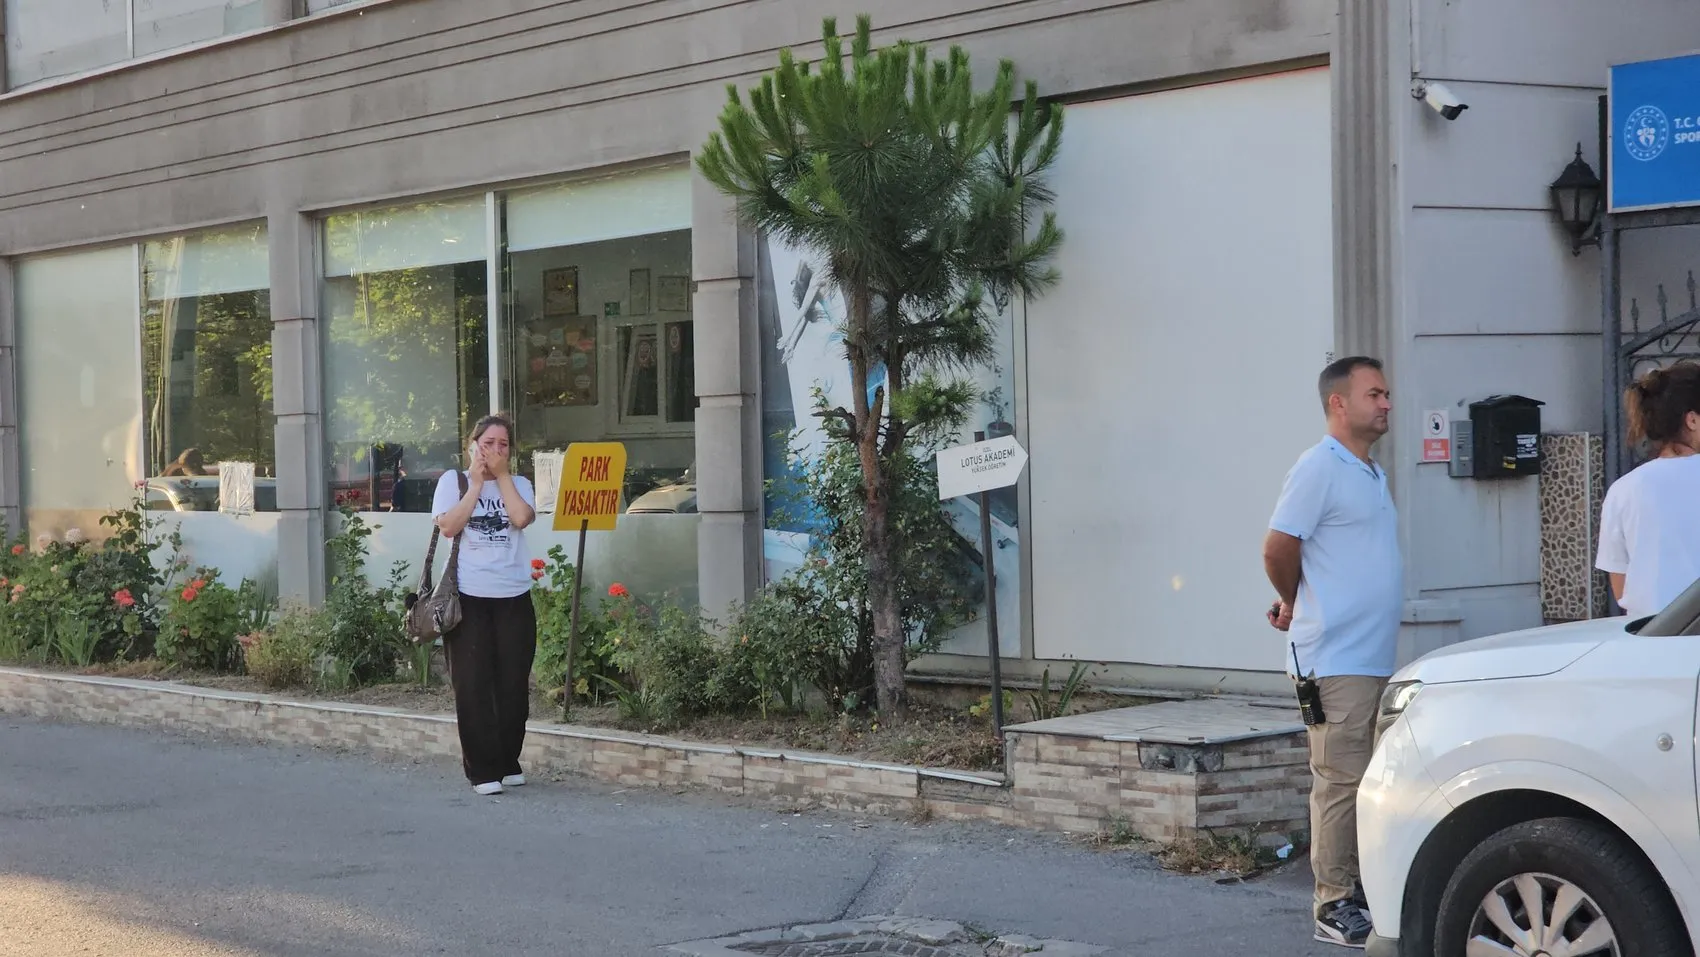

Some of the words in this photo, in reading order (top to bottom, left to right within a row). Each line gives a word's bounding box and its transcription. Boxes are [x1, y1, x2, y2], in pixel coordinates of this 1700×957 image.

[1673, 117, 1695, 128] T.C.
[579, 456, 611, 481] PARK
[961, 455, 983, 468] LOTUS
[984, 445, 1016, 463] AKADEMİ
[563, 489, 618, 515] YASAKTIR
